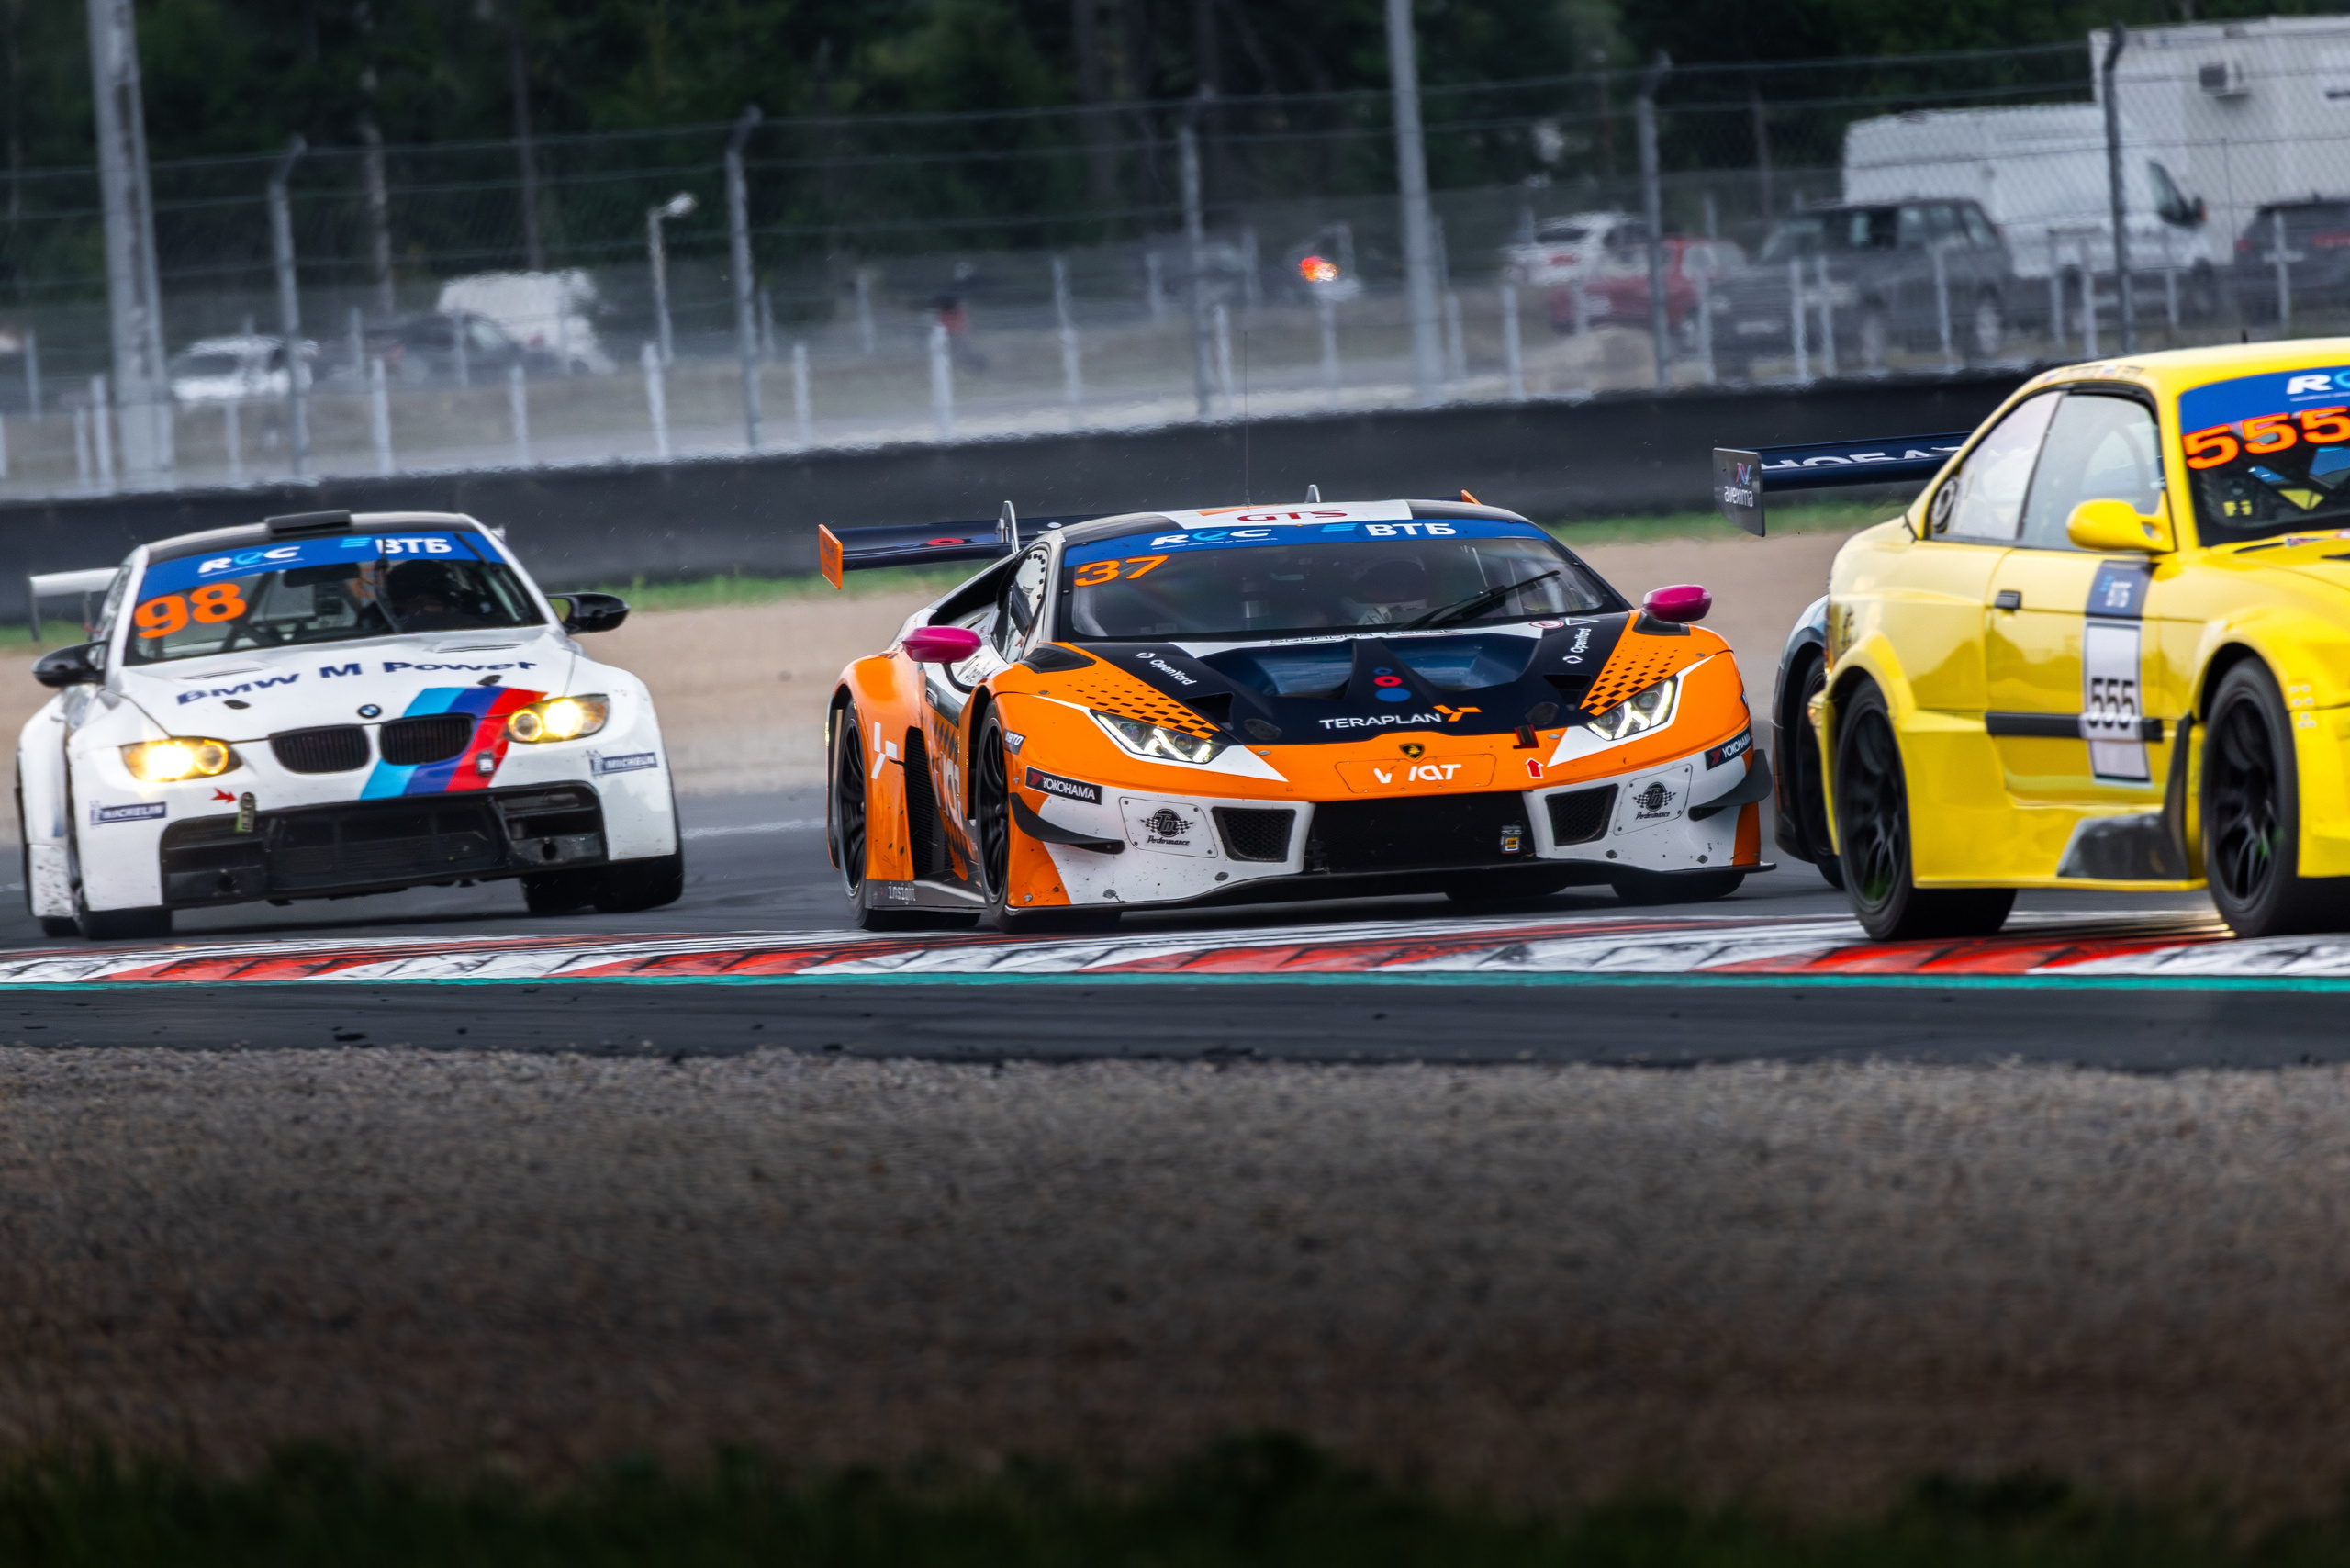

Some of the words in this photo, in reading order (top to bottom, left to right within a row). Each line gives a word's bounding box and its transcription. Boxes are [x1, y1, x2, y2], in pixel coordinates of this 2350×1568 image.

[2182, 406, 2350, 470] 555
[1724, 483, 1753, 508] avexima
[1237, 510, 1348, 522] GTS
[1365, 522, 1457, 537] ВТБ
[1073, 554, 1169, 588] 37
[134, 582, 247, 639] 98
[176, 673, 300, 705] BMW
[319, 662, 364, 678] M
[382, 660, 538, 674] Power
[1149, 659, 1198, 686] OpenYard
[2087, 678, 2135, 730] 555
[1318, 712, 1442, 730] TERAPLAN
[1042, 776, 1096, 801] YOKOHAMA
[1147, 834, 1191, 846] Performance
